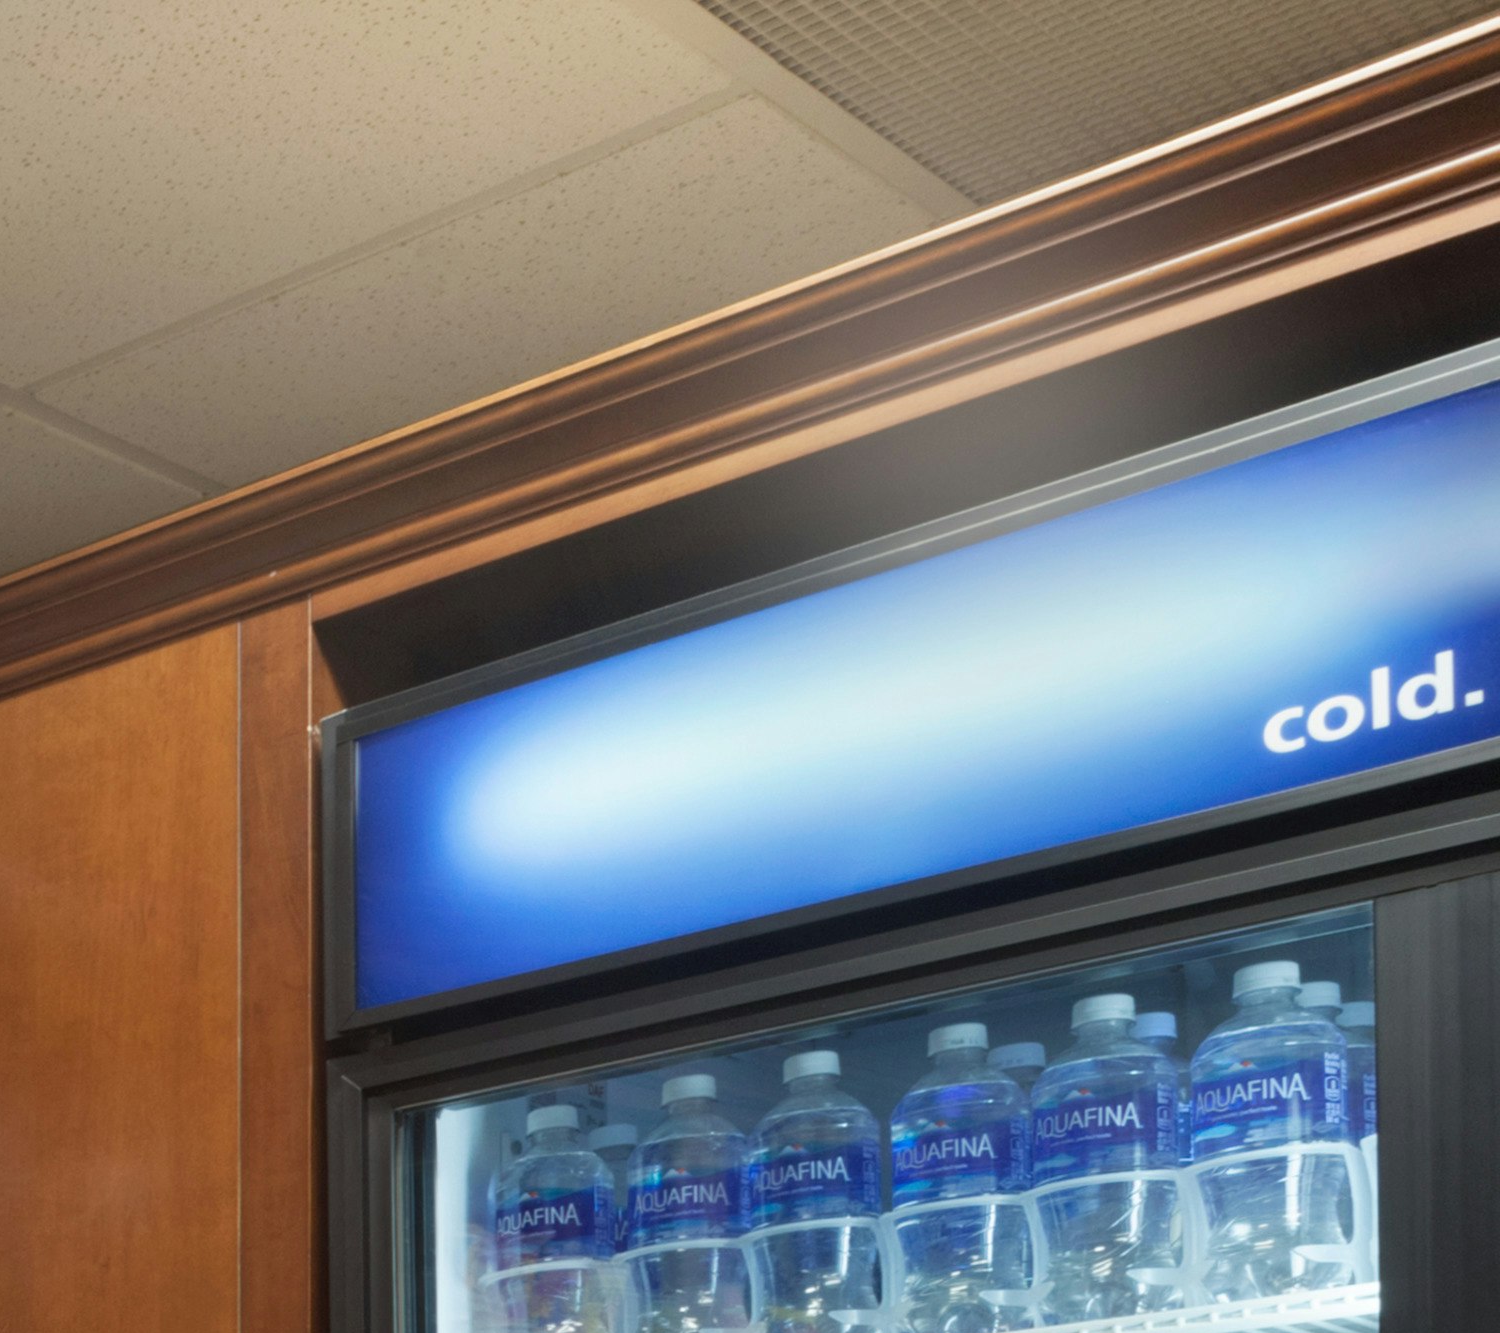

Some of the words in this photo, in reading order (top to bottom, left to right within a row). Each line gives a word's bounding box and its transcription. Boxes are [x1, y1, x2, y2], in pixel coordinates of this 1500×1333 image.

[1263, 649, 1485, 753] cold.
[1195, 1073, 1311, 1114] AQUAFINA
[1035, 1101, 1143, 1140] AQUAFINA
[634, 1181, 729, 1214] AQUAFINA
